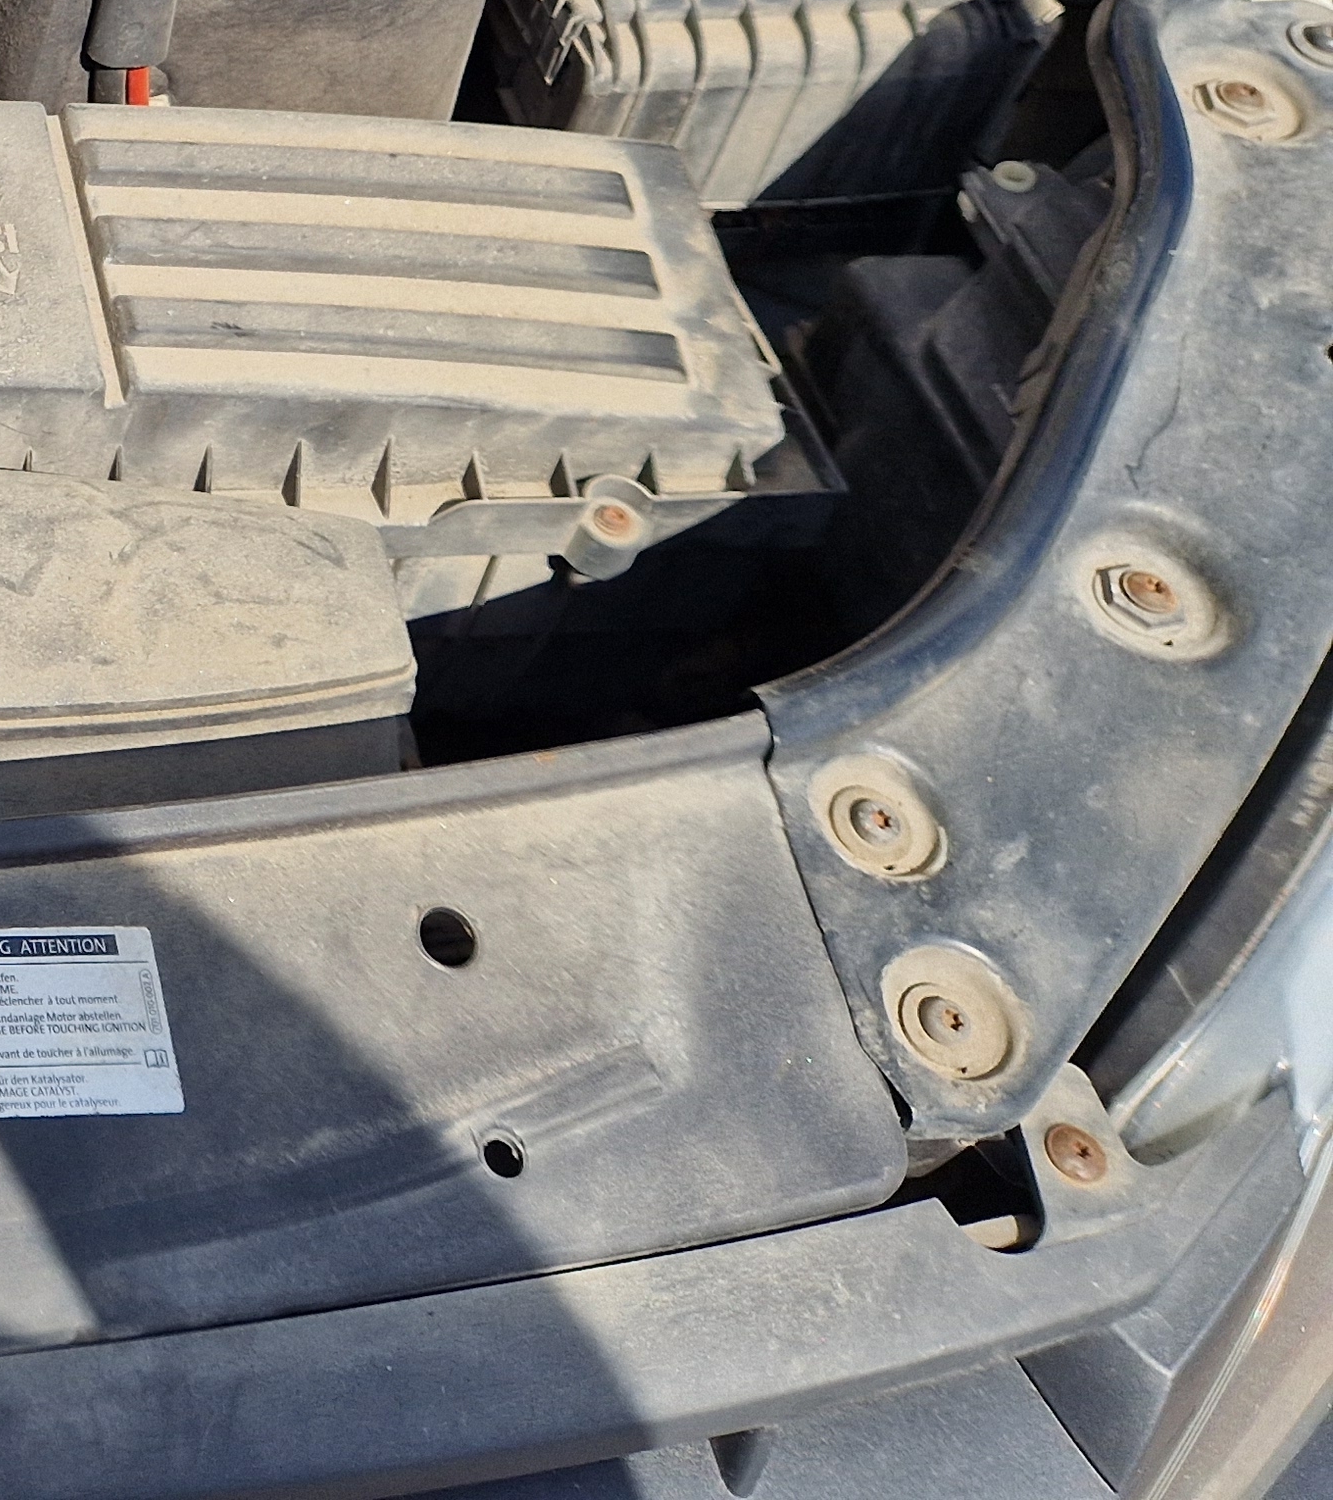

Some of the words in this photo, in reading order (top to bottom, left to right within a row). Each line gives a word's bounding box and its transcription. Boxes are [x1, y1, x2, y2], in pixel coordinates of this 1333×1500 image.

[20, 938, 108, 955] ATTENTION
[55, 996, 76, 1005] tout
[46, 1012, 76, 1022] Motor
[9, 1024, 44, 1035] BEFORE
[47, 1023, 100, 1034] TOUCHING
[102, 1022, 146, 1032] IGNITION
[23, 1049, 35, 1058] de
[36, 1047, 74, 1058] toucher
[10, 1074, 29, 1084] den
[31, 1073, 87, 1085] Katalysator.
[30, 1086, 79, 1097] CATALYST.
[34, 1100, 56, 1111] pour
[58, 1098, 67, 1108] le
